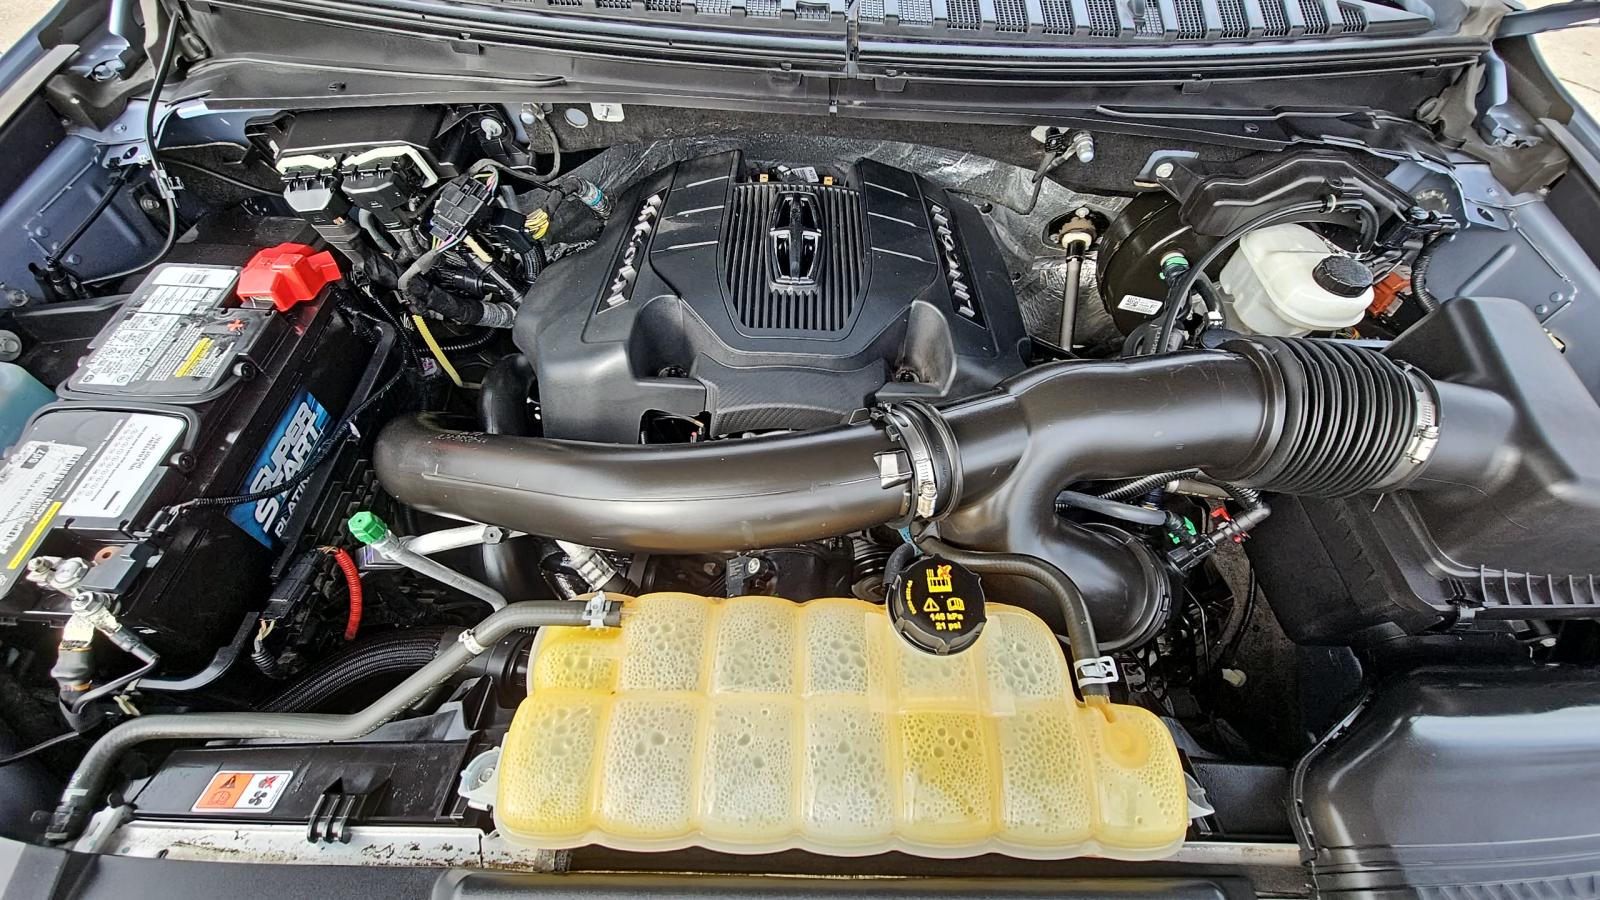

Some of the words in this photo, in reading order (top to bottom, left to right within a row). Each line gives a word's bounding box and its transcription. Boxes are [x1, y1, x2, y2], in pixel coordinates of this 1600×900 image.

[931, 204, 976, 317] LINCOLN
[250, 401, 313, 494] SUPER
[275, 473, 314, 538] PLATIN
